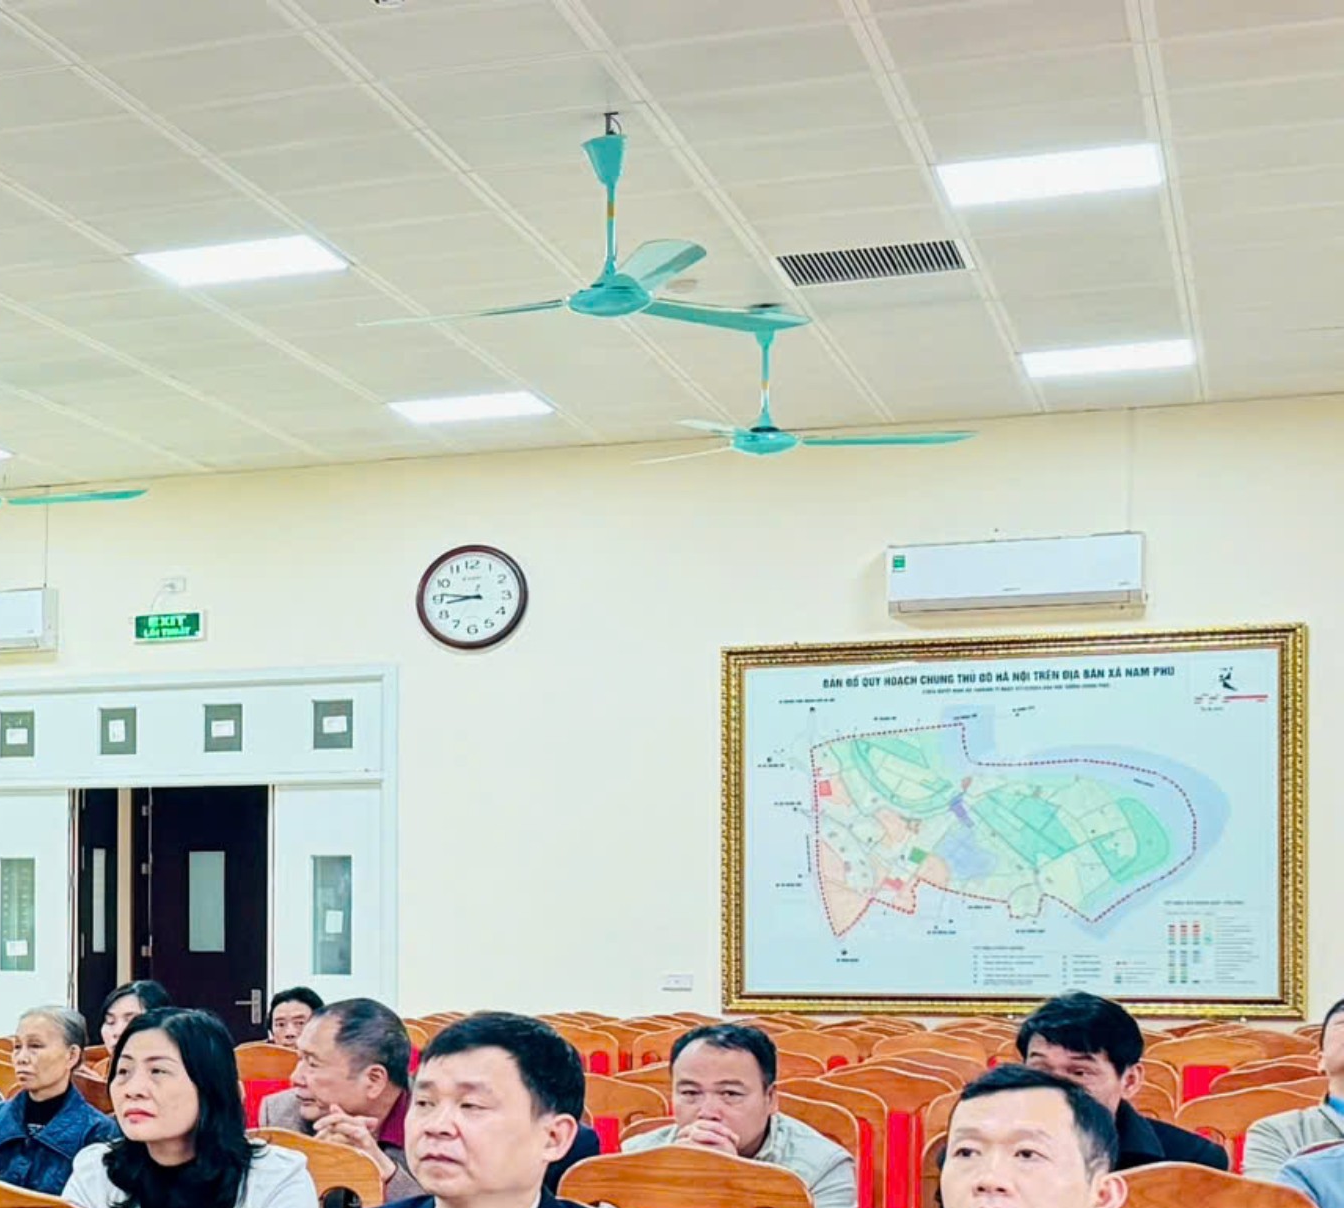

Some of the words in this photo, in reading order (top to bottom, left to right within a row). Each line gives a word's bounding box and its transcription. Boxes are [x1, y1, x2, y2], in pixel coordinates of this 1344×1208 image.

[450, 564, 460, 574] 11
[465, 560, 480, 570] 12
[437, 578, 451, 588] 10
[497, 574, 506, 584] 2
[148, 615, 187, 627] EXIT
[920, 673, 954, 686] CHUNG
